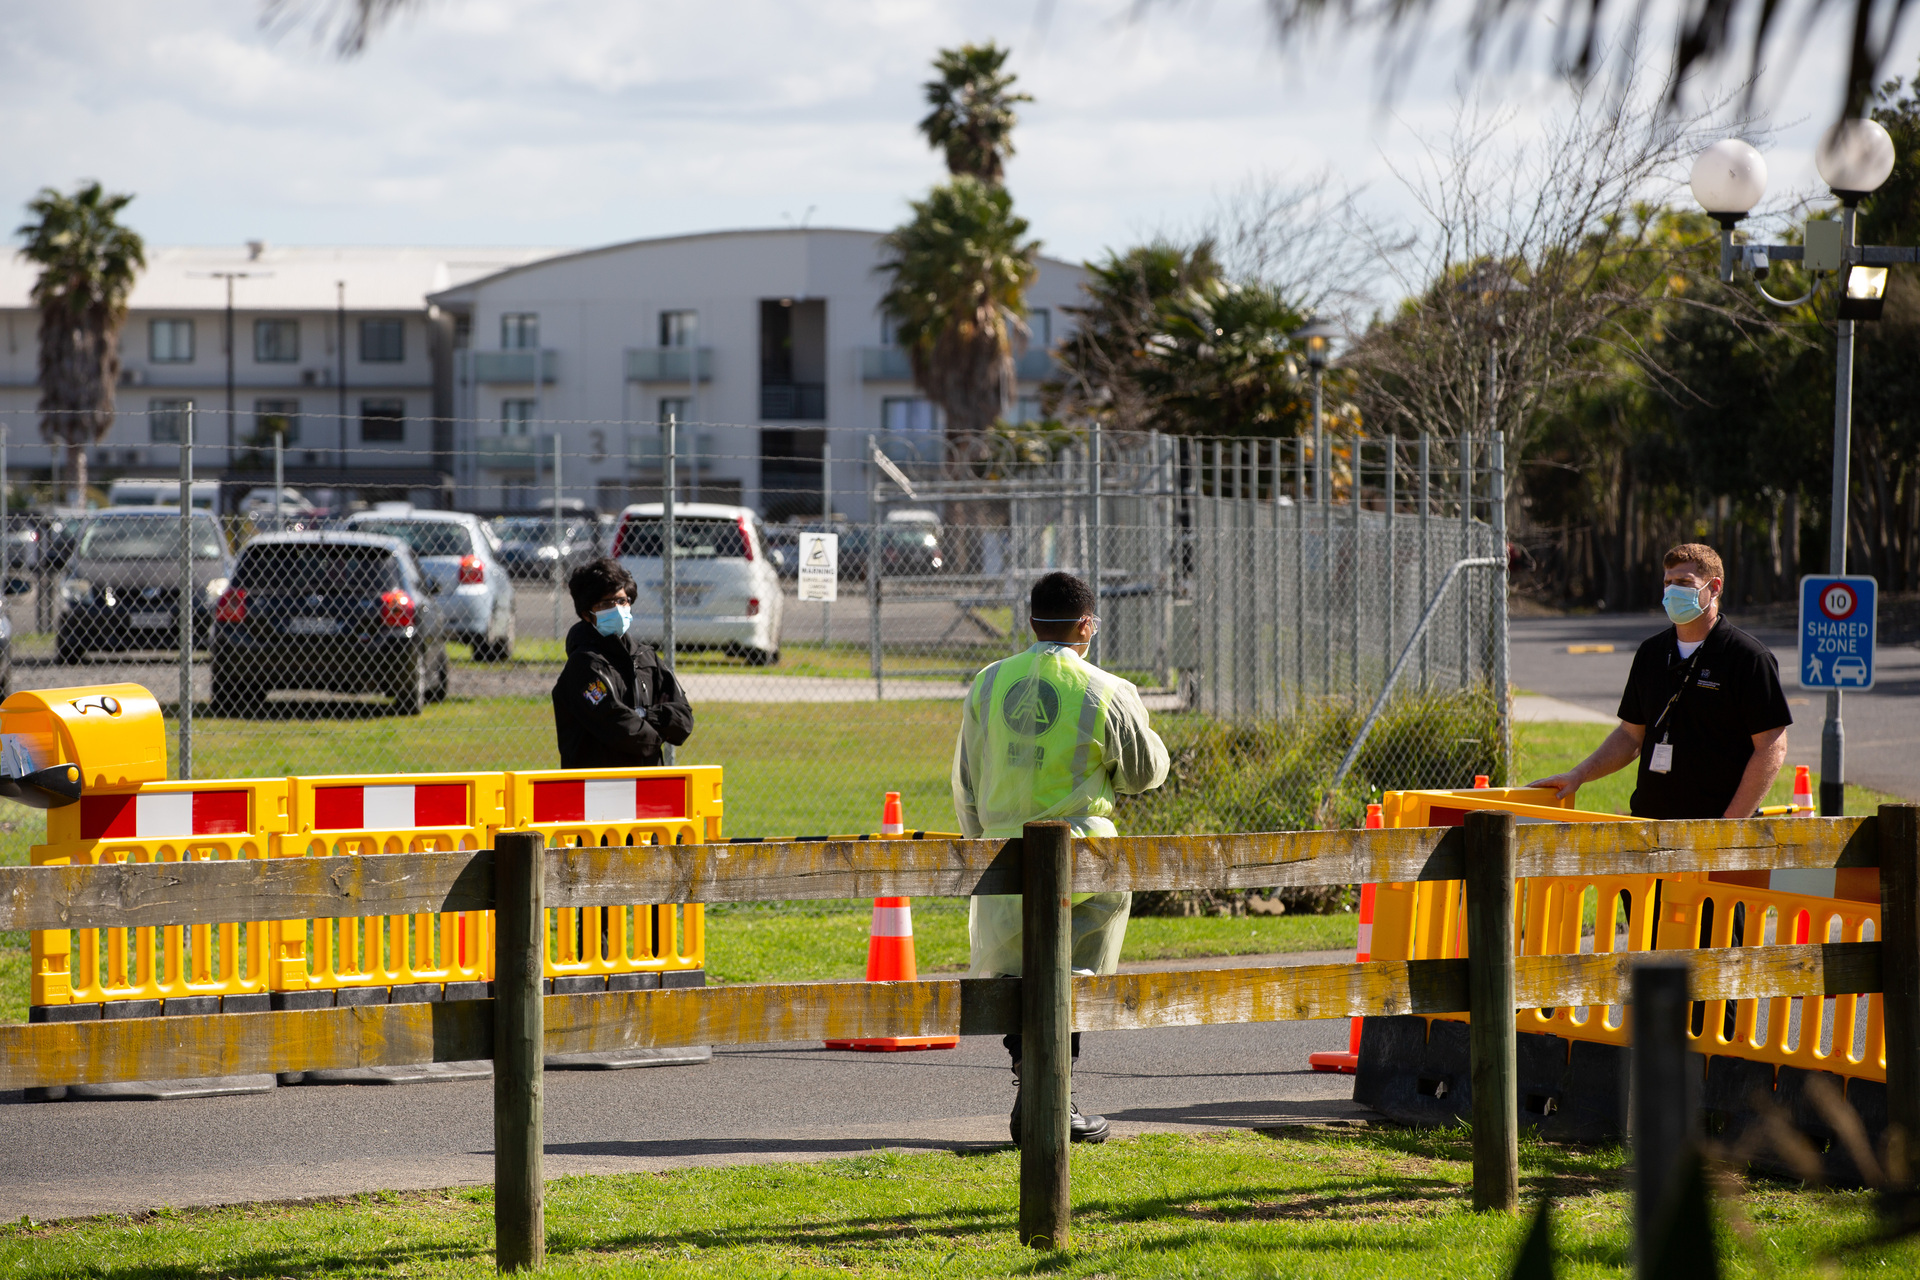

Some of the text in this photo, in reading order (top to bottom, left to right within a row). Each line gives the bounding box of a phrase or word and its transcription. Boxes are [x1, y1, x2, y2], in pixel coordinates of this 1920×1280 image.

[588, 428, 607, 466] 3
[801, 567, 835, 575] WARNING
[1830, 594, 1847, 609] 10
[1807, 621, 1868, 638] SHARED
[1817, 638, 1857, 654] ZONE
